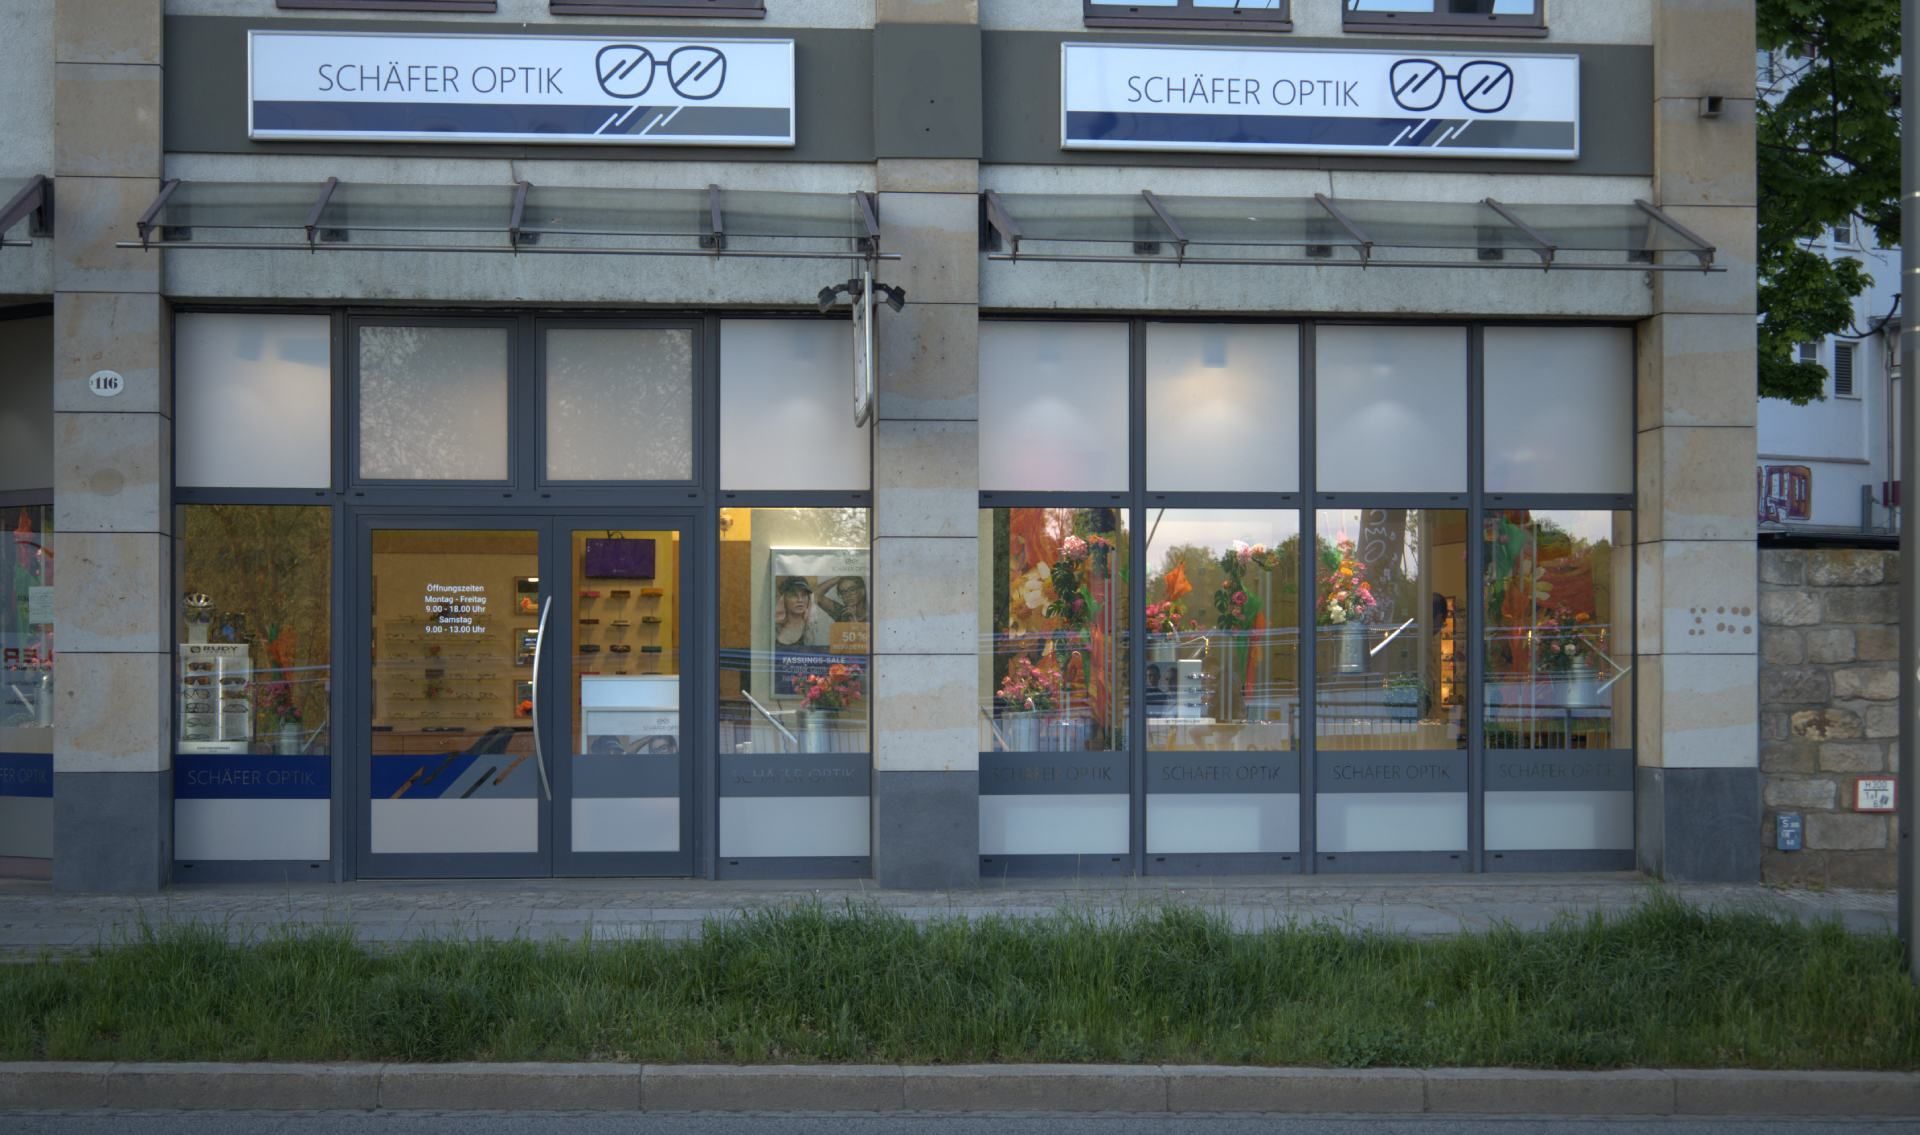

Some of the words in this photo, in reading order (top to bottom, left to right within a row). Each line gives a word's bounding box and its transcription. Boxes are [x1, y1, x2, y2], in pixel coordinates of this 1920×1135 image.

[318, 60, 459, 93] SCHÄFER
[471, 65, 564, 95] OPTIK
[1127, 72, 1260, 105] SCHÄFER
[1272, 78, 1360, 108] OPTIK
[95, 376, 118, 390] 116
[427, 584, 484, 593] Öffnungszeiten
[425, 595, 453, 604] Montag
[460, 595, 487, 604] Freitag
[425, 605, 443, 613] 9.00
[449, 605, 471, 613] 18.00
[472, 605, 486, 613] Uhr
[439, 616, 472, 625] Samstag
[425, 625, 443, 633] 9.00
[449, 625, 471, 633] 13.00
[472, 625, 486, 633] Uhr
[841, 631, 856, 642] 50
[782, 656, 847, 664] FASSUNGS-SALE
[187, 767, 260, 785] SCHÄFER
[267, 769, 316, 785] OPTIK
[1235, 766, 1281, 781] OPTIK
[1406, 764, 1450, 780] OPTIK
